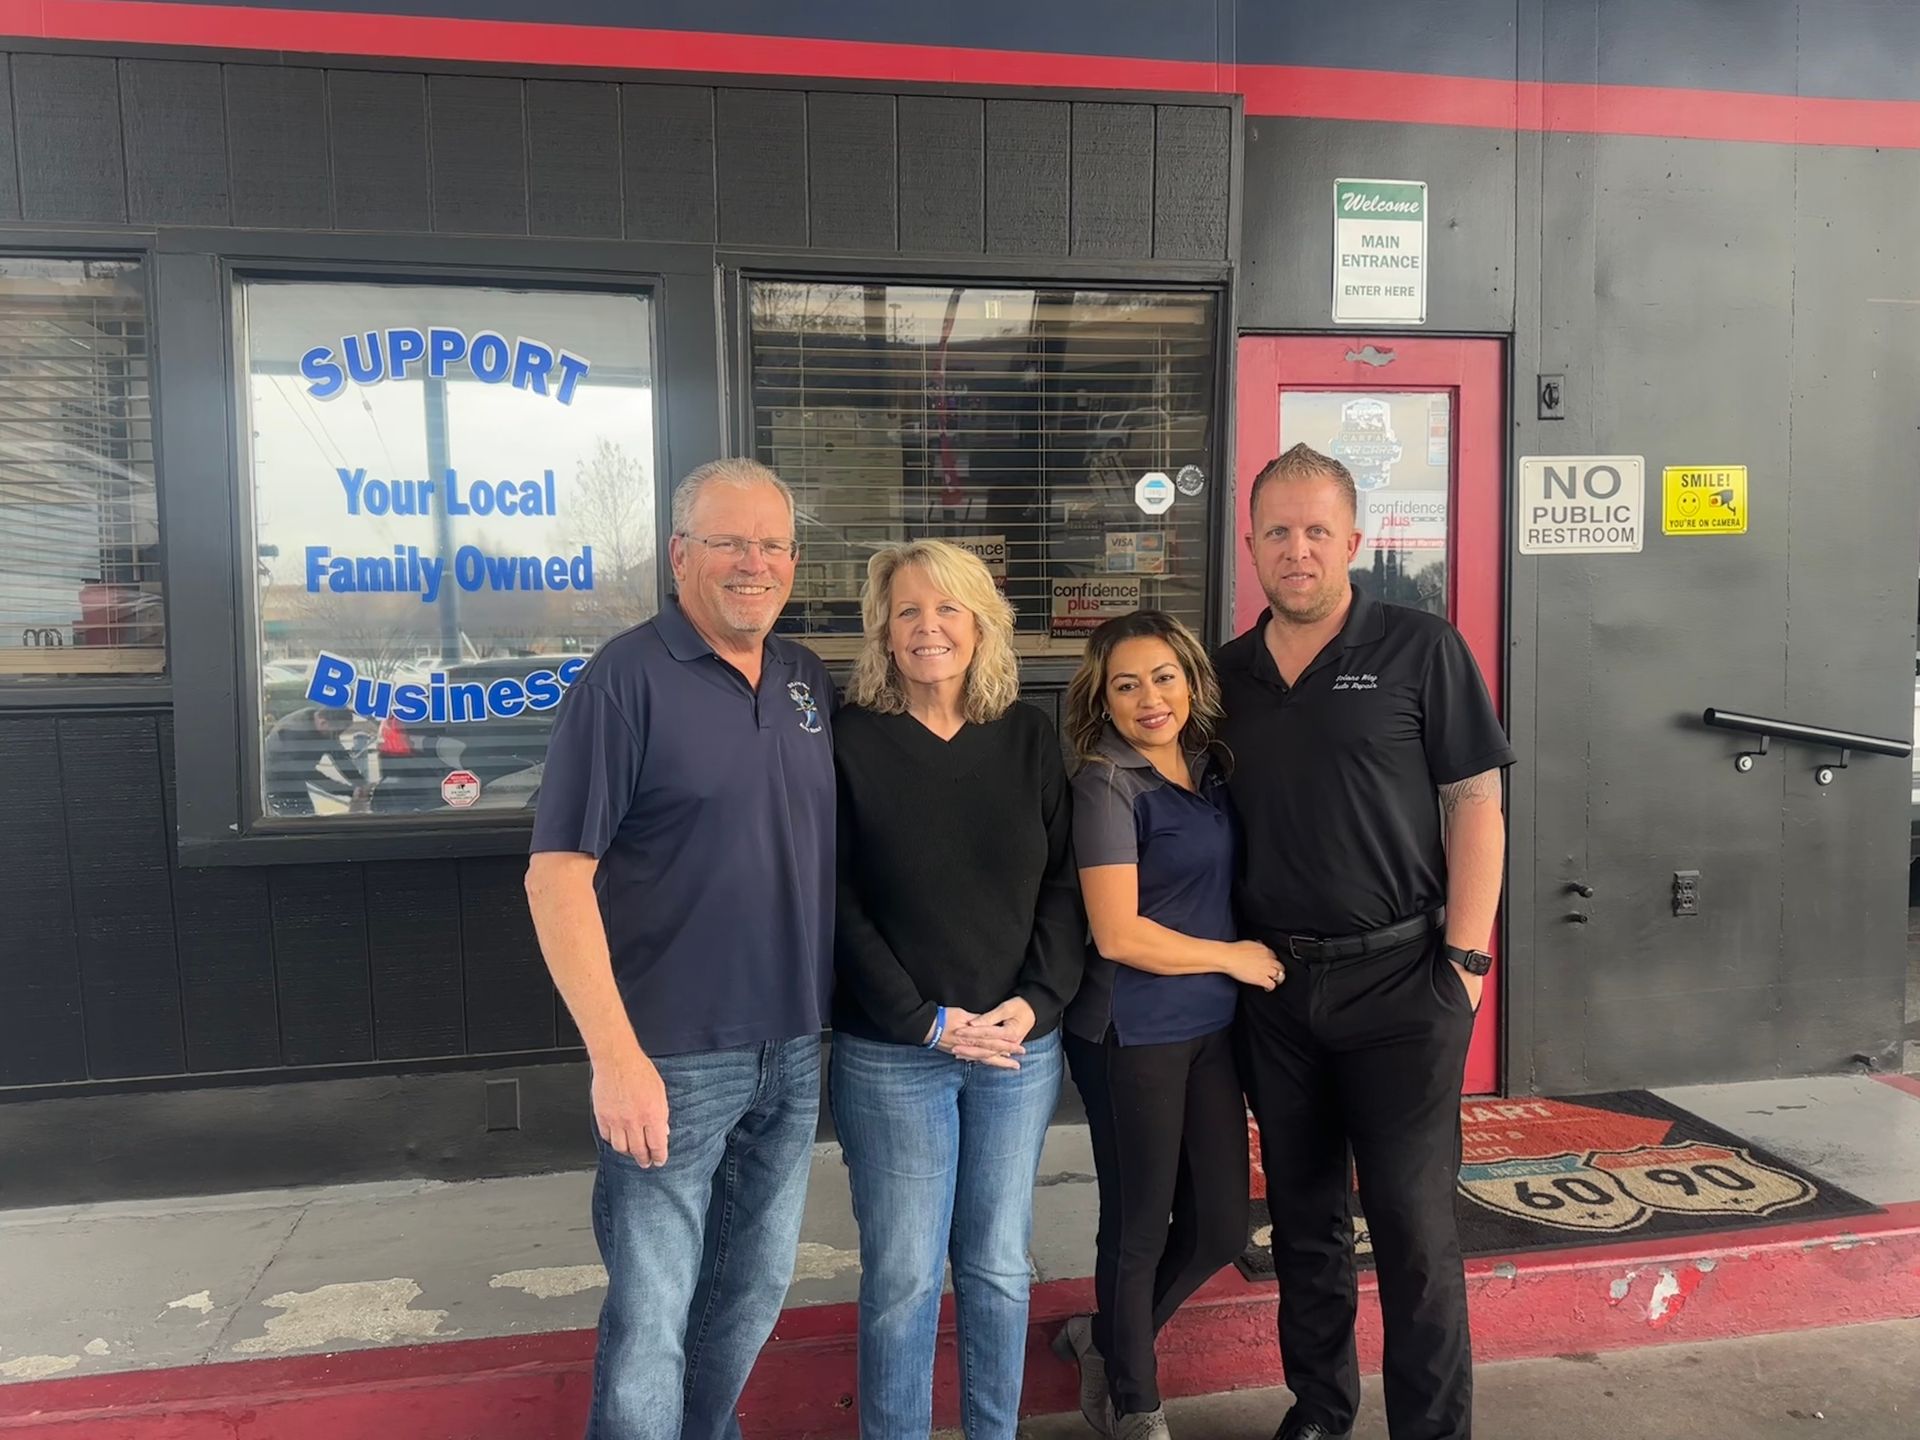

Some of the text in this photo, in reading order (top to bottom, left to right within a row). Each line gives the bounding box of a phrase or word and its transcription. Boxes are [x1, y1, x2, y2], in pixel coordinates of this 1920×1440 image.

[1341, 192, 1420, 213] Welcome
[1361, 235, 1400, 249] MAIN
[1341, 254, 1420, 269] ENTRANCE
[1345, 285, 1415, 297] ENTER HERE
[300, 327, 592, 406] SUPPORT
[1543, 465, 1622, 500] NO
[1681, 473, 1730, 488] SMILE!
[337, 468, 557, 517] Your Local
[1369, 501, 1446, 514] confidence
[1533, 506, 1631, 524] PUBLIC
[1381, 514, 1410, 530] plus
[1669, 518, 1741, 528] YOU'RE ON CAMERA
[1111, 538, 1134, 547] VISA
[1528, 527, 1635, 544] RESTROOM
[305, 544, 595, 602] Family Owned
[1053, 582, 1138, 597] confidence
[1068, 597, 1100, 614] plus
[1644, 1164, 1756, 1197] 90
[1514, 1178, 1616, 1210] 60
